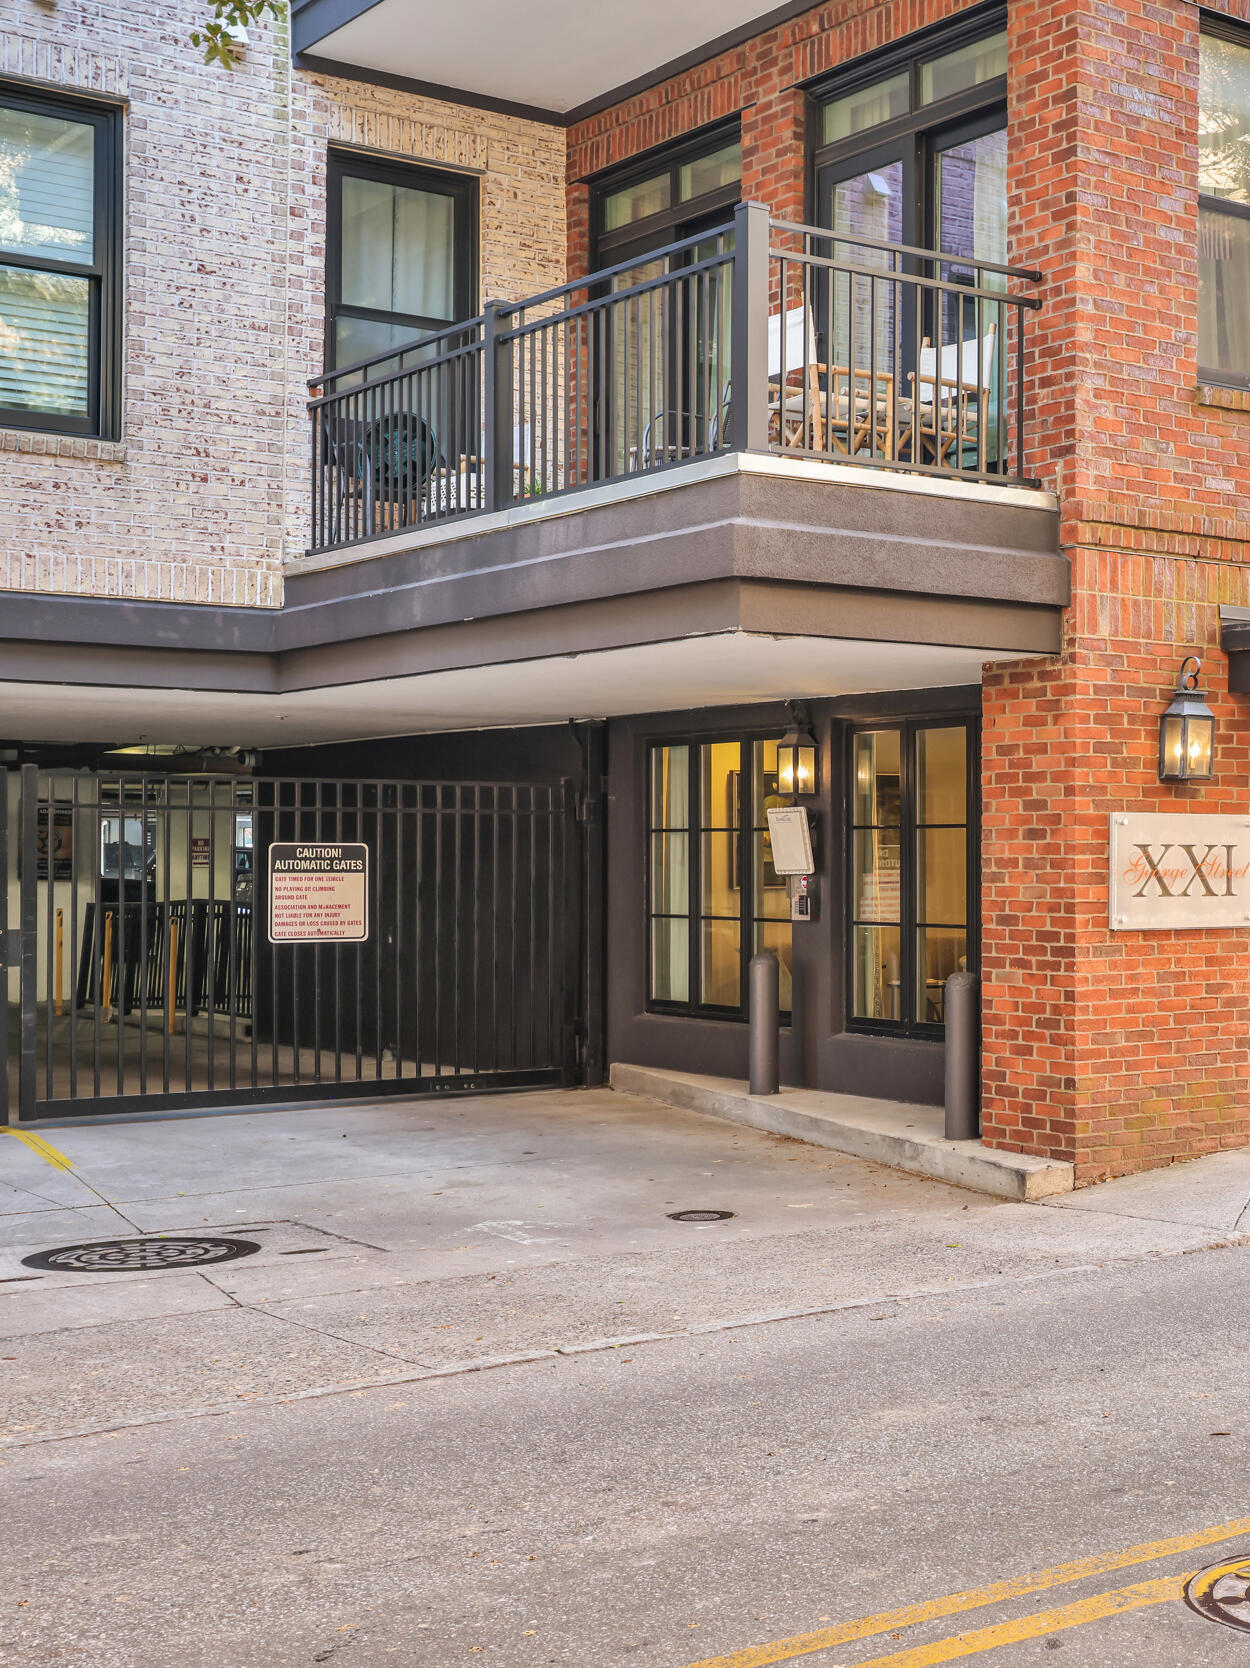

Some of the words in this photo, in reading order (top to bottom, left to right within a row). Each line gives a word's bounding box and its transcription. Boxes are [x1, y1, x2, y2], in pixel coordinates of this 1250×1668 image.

[274, 860, 331, 870] AUTOMATIC
[332, 860, 363, 870] GATES
[296, 848, 342, 858] CAUTION!
[1123, 851, 1188, 890] George
[1194, 853, 1250, 880] Street
[1131, 844, 1238, 898] XXI
